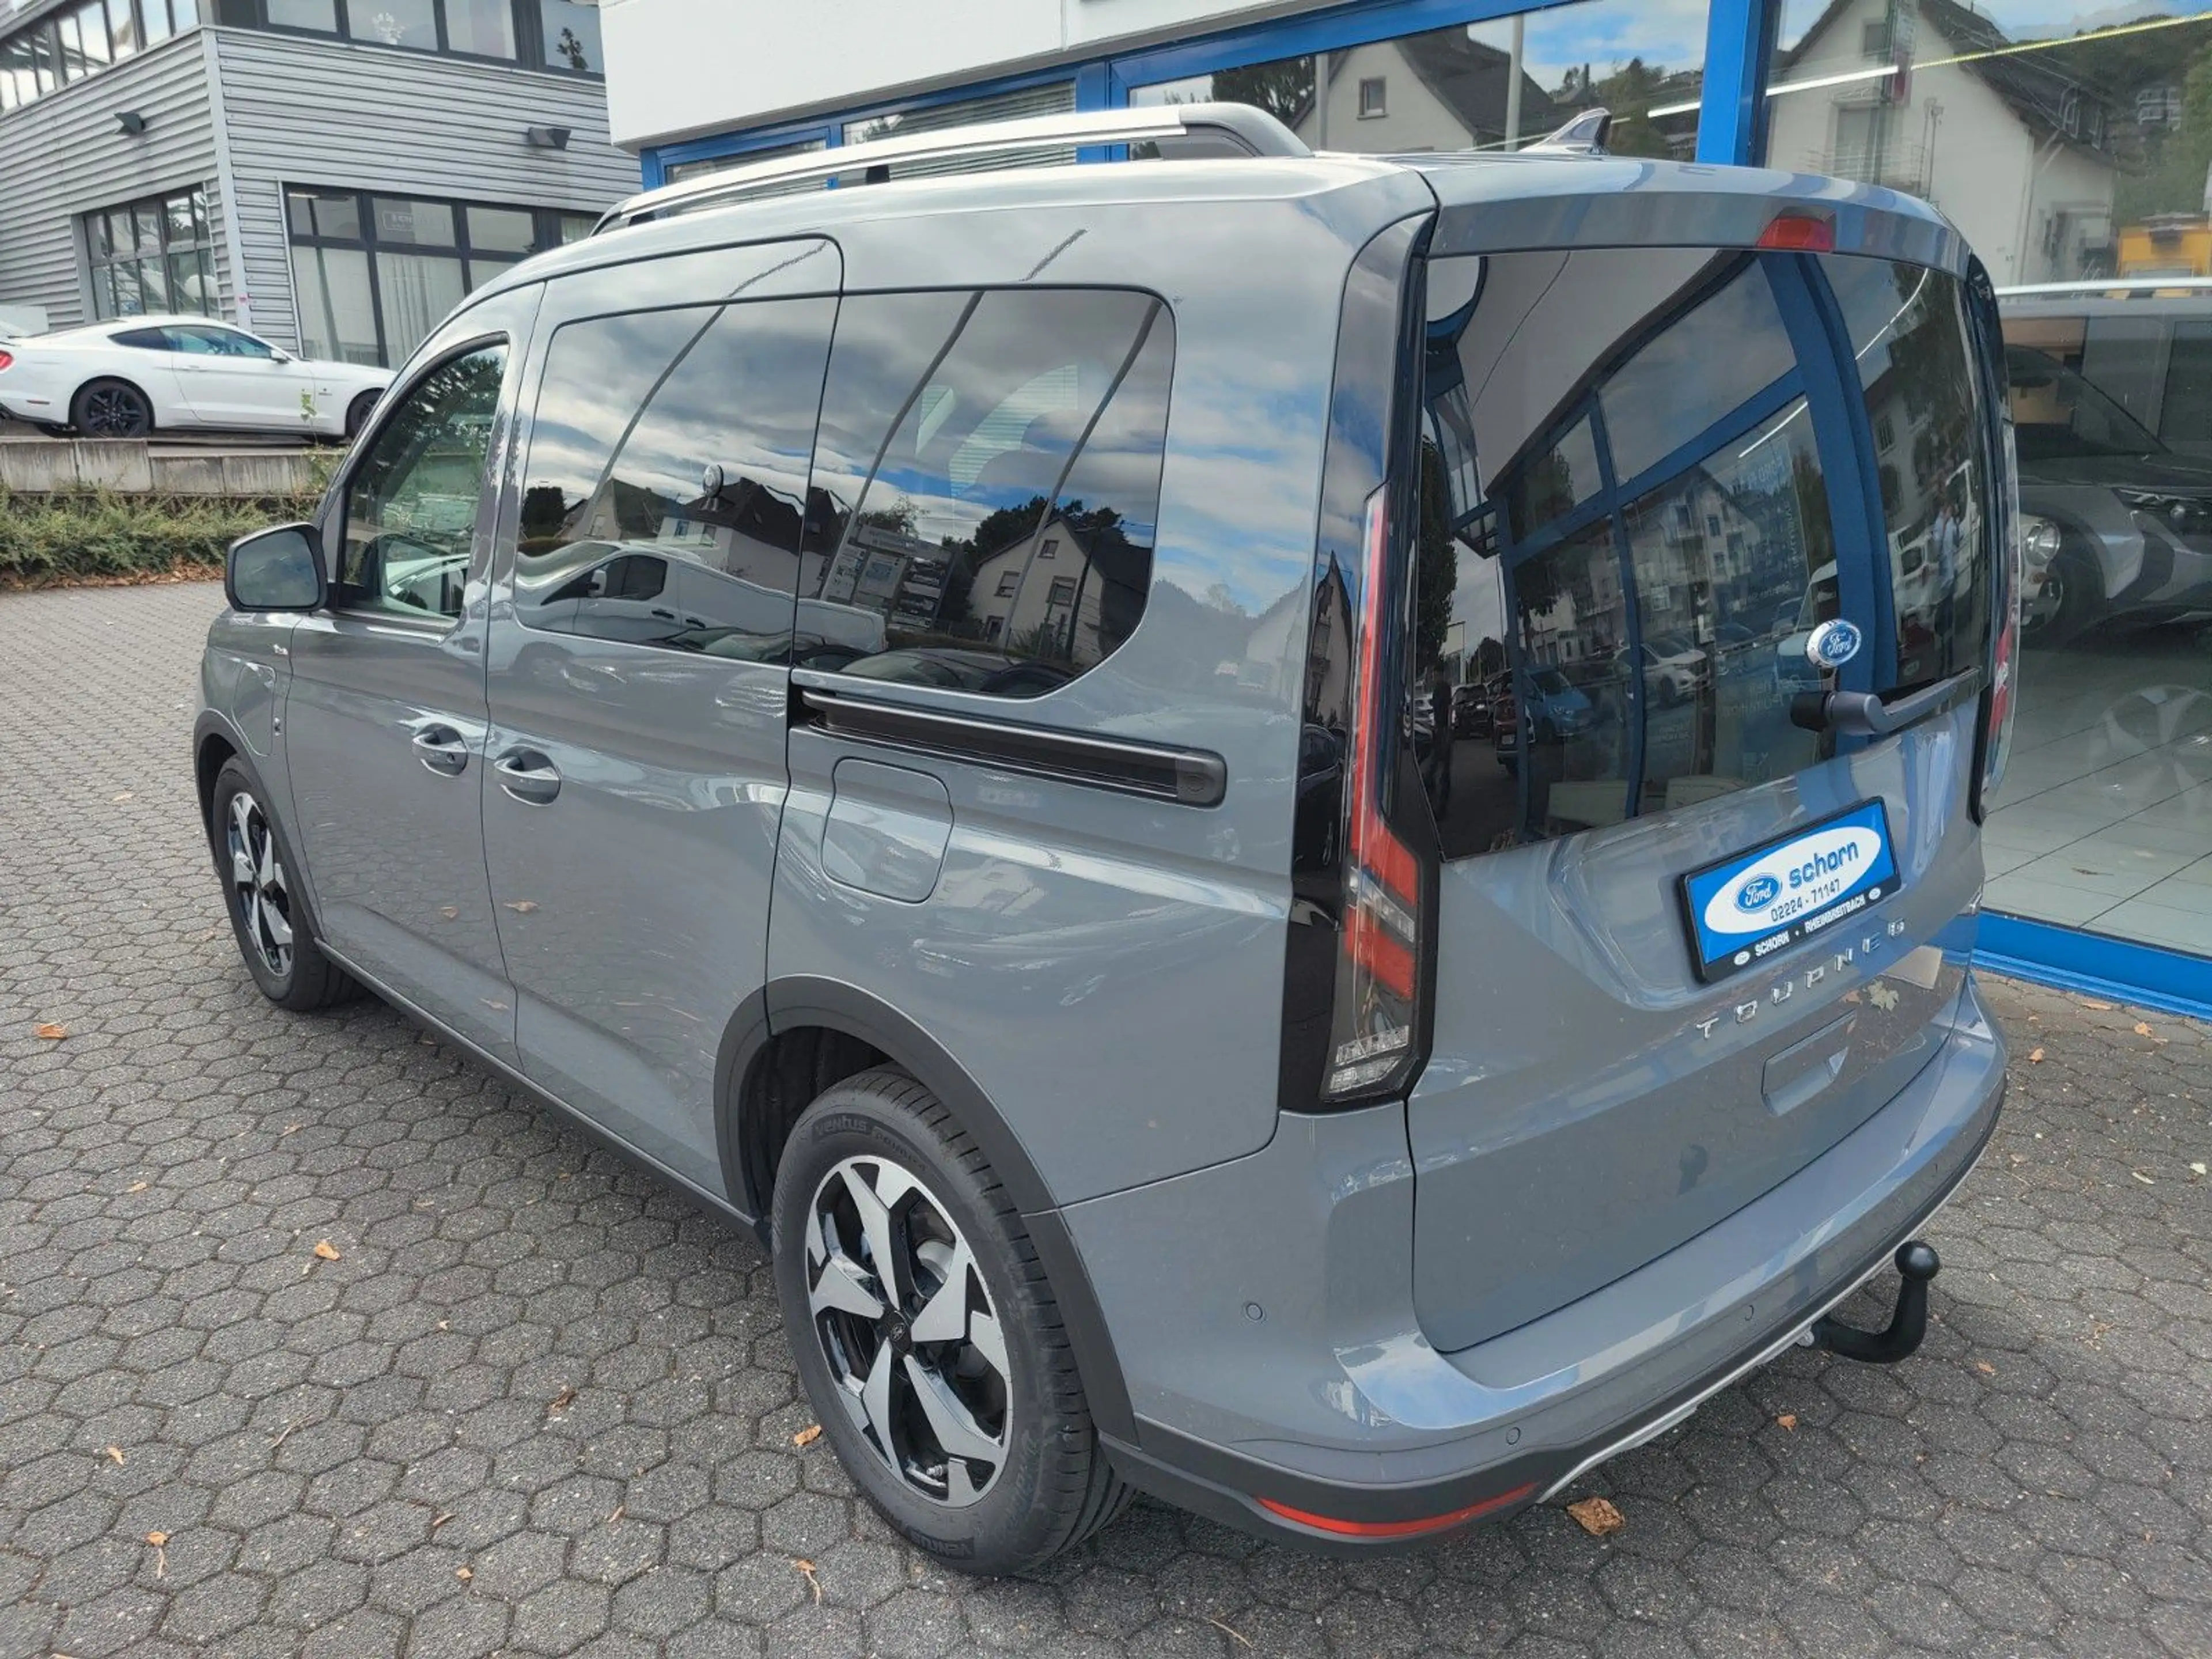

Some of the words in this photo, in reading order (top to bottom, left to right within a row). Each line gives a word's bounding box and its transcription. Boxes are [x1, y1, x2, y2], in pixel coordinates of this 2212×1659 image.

[1826, 632, 1853, 657] Ford
[1745, 880, 1772, 906] Ford
[1789, 841, 1859, 889] schorn
[1771, 896, 1803, 922] 02224
[1810, 878, 1840, 903] 71147
[1754, 930, 1790, 957] SCHORN
[1695, 918, 1904, 1039] TOURNEO
